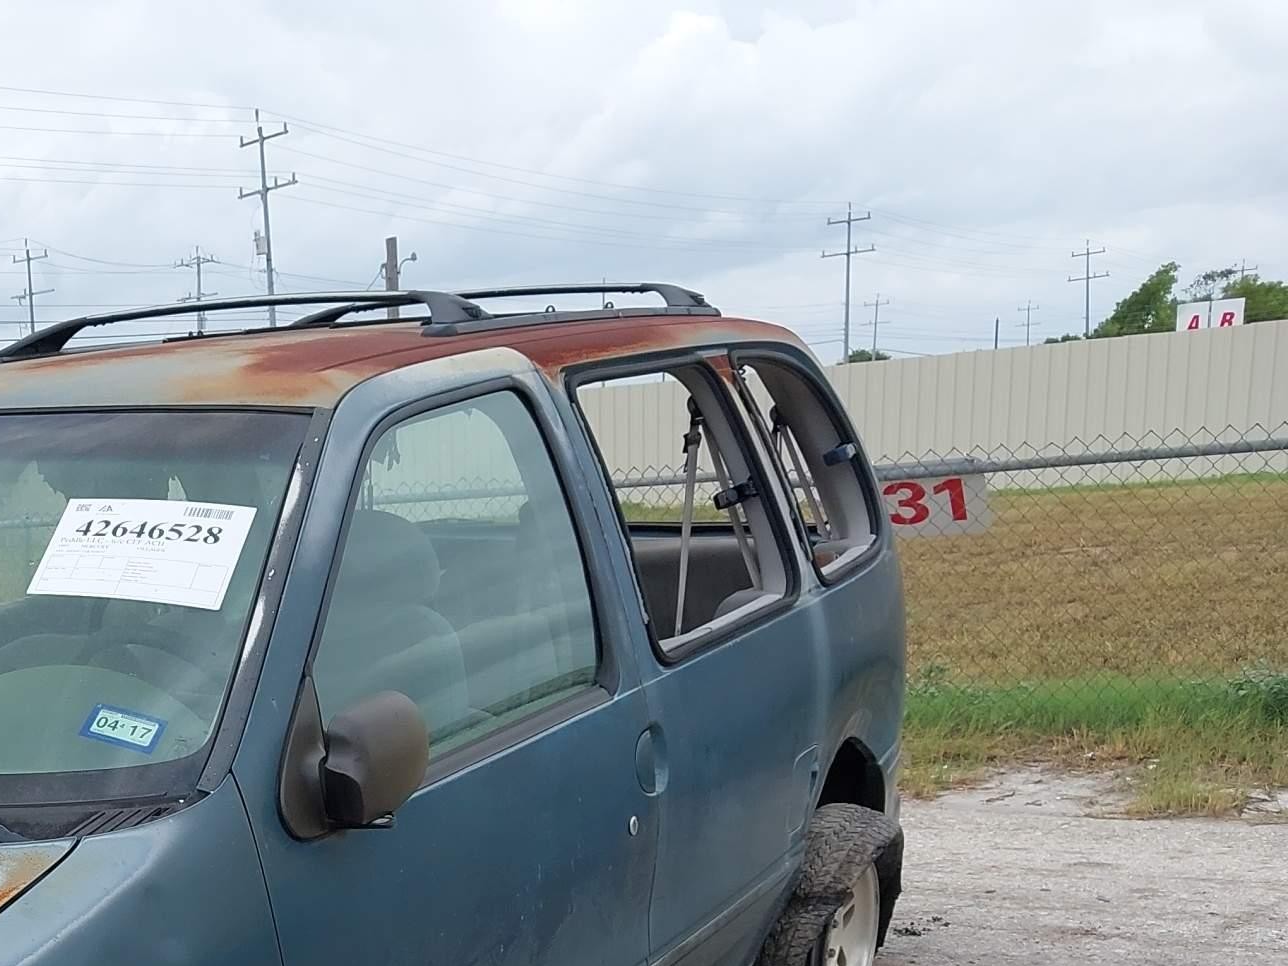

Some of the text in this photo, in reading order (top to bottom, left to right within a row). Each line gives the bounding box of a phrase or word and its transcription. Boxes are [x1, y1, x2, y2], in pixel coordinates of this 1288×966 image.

[882, 477, 968, 526] 31
[75, 519, 223, 545] 42646528
[96, 716, 153, 739] 04 17
